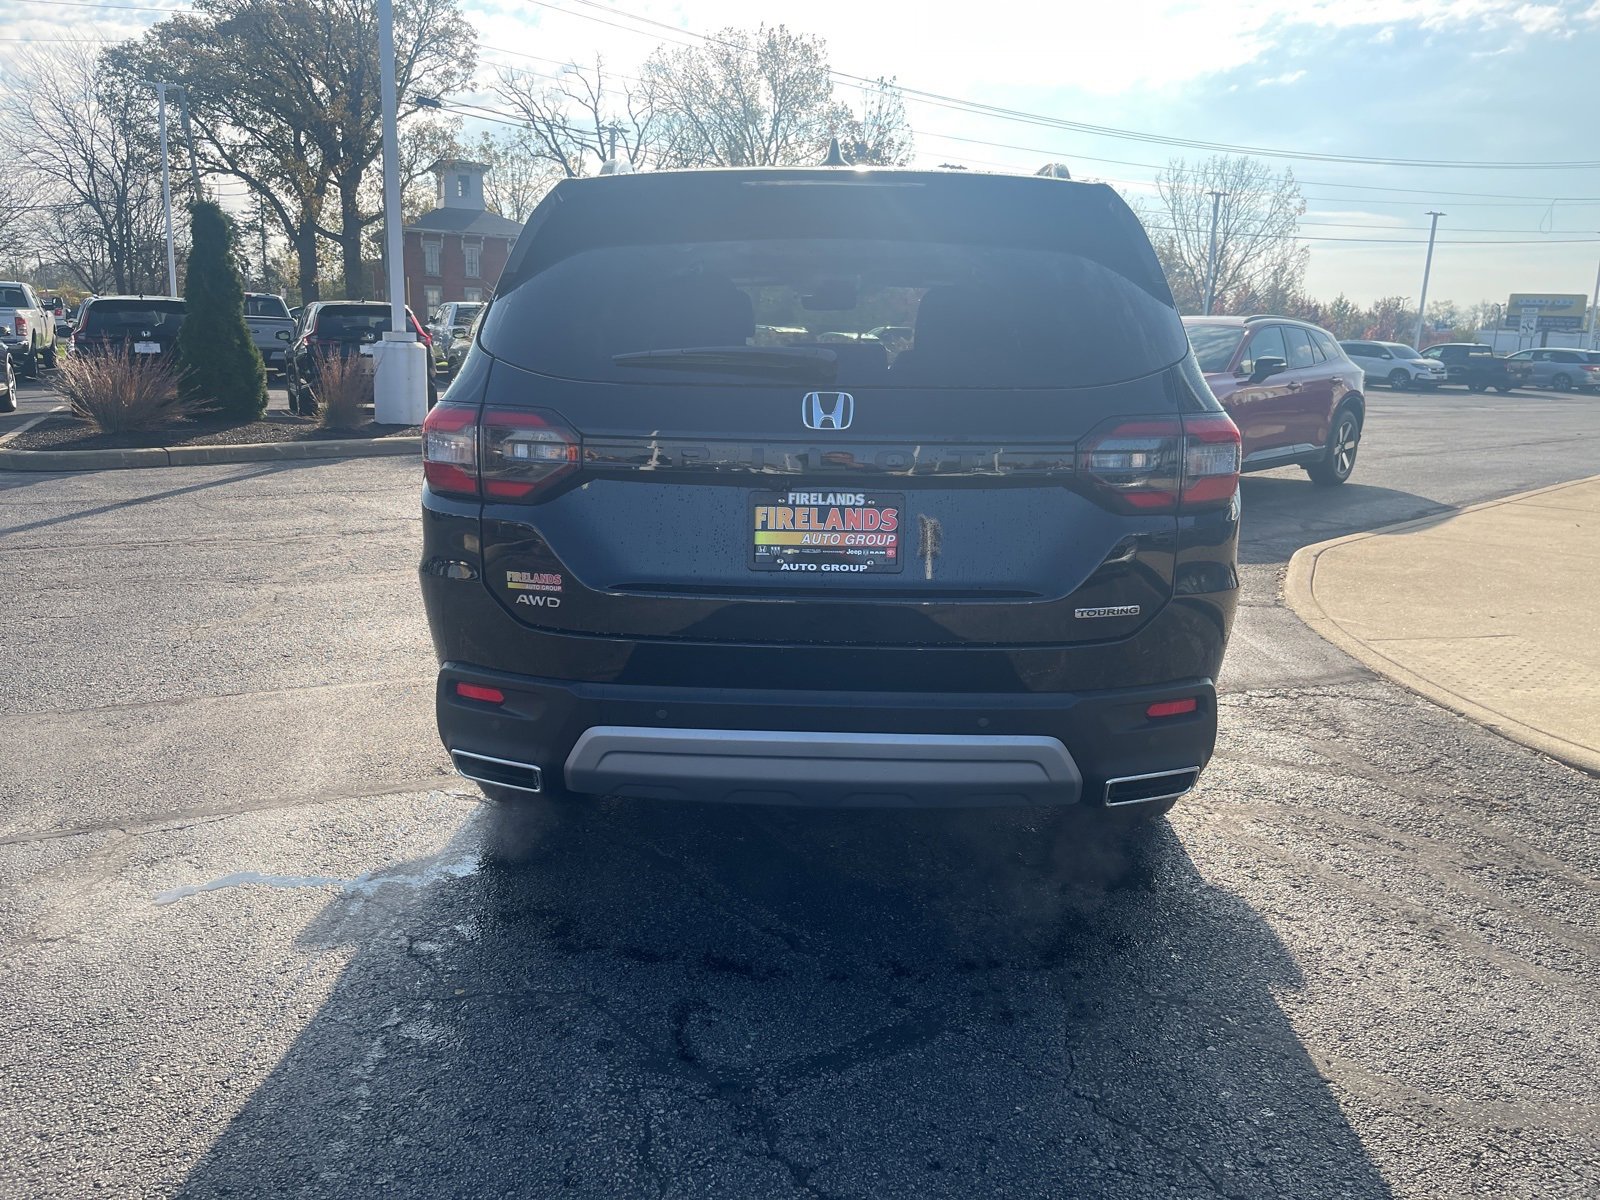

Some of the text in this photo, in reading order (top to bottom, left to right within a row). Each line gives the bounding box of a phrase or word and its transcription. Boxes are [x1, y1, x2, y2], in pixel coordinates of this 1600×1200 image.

[788, 492, 866, 506] FIRELANDS
[754, 506, 899, 532] FIRELANDS
[801, 534, 896, 546] AUTO GROUP
[846, 548, 862, 556] Jeep
[780, 563, 868, 572] AUTO GROUP
[506, 570, 562, 585] FIRELANDS
[541, 584, 562, 592] GROUP
[515, 594, 561, 608] AWD
[1077, 606, 1139, 617] TOURING
